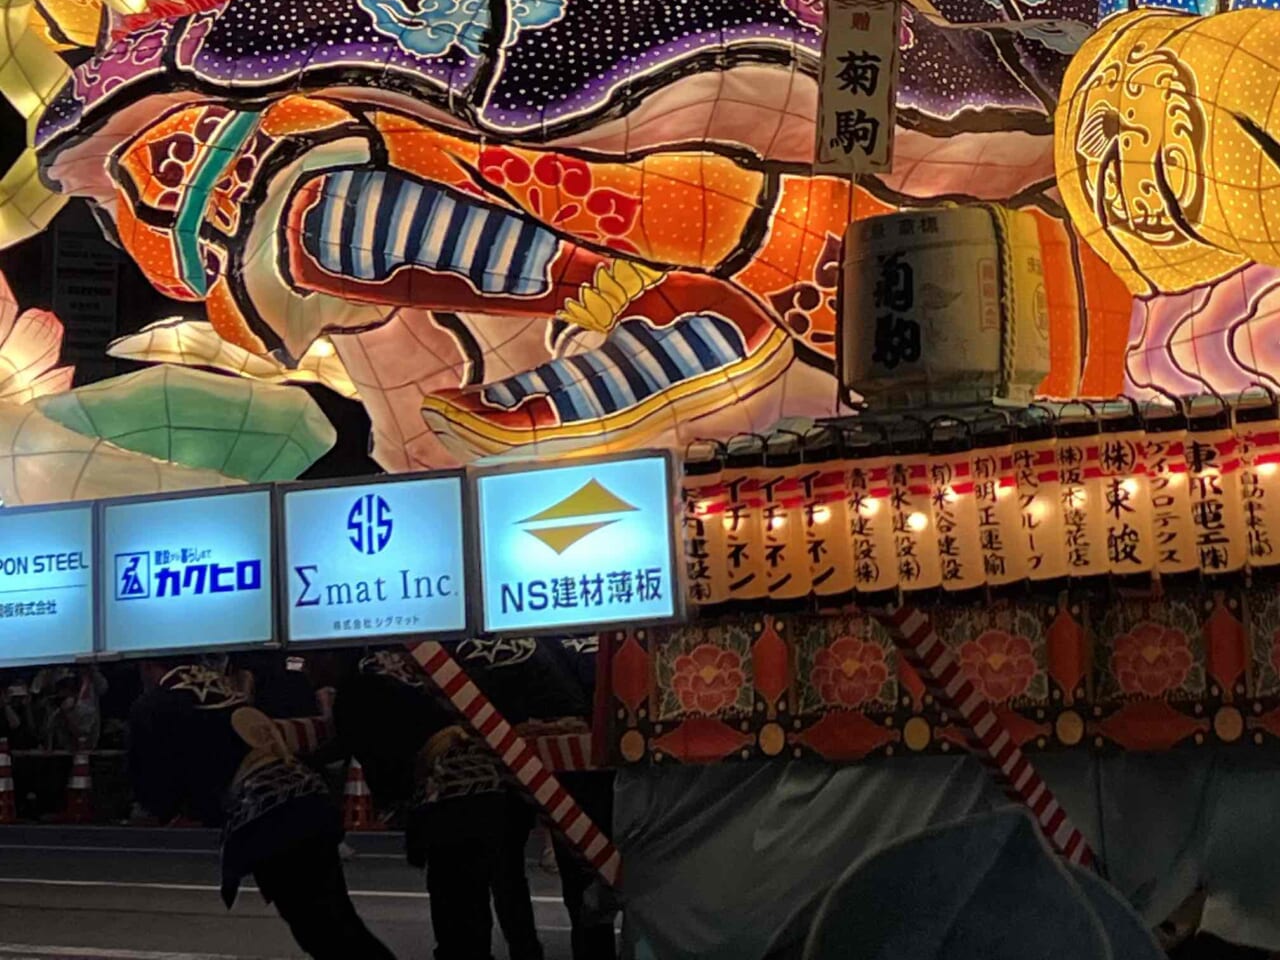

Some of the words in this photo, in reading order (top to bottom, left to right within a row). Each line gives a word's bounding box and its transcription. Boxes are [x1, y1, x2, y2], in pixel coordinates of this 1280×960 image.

[829, 49, 882, 157] 菊駒
[33, 551, 89, 574] STEEL
[724, 475, 756, 591] イチネン
[760, 475, 792, 592] イチネン
[800, 470, 835, 586] イチネン
[154, 559, 262, 598] カクヒロ
[401, 569, 459, 600] Inc.
[501, 567, 663, 614] NS建材薄板
